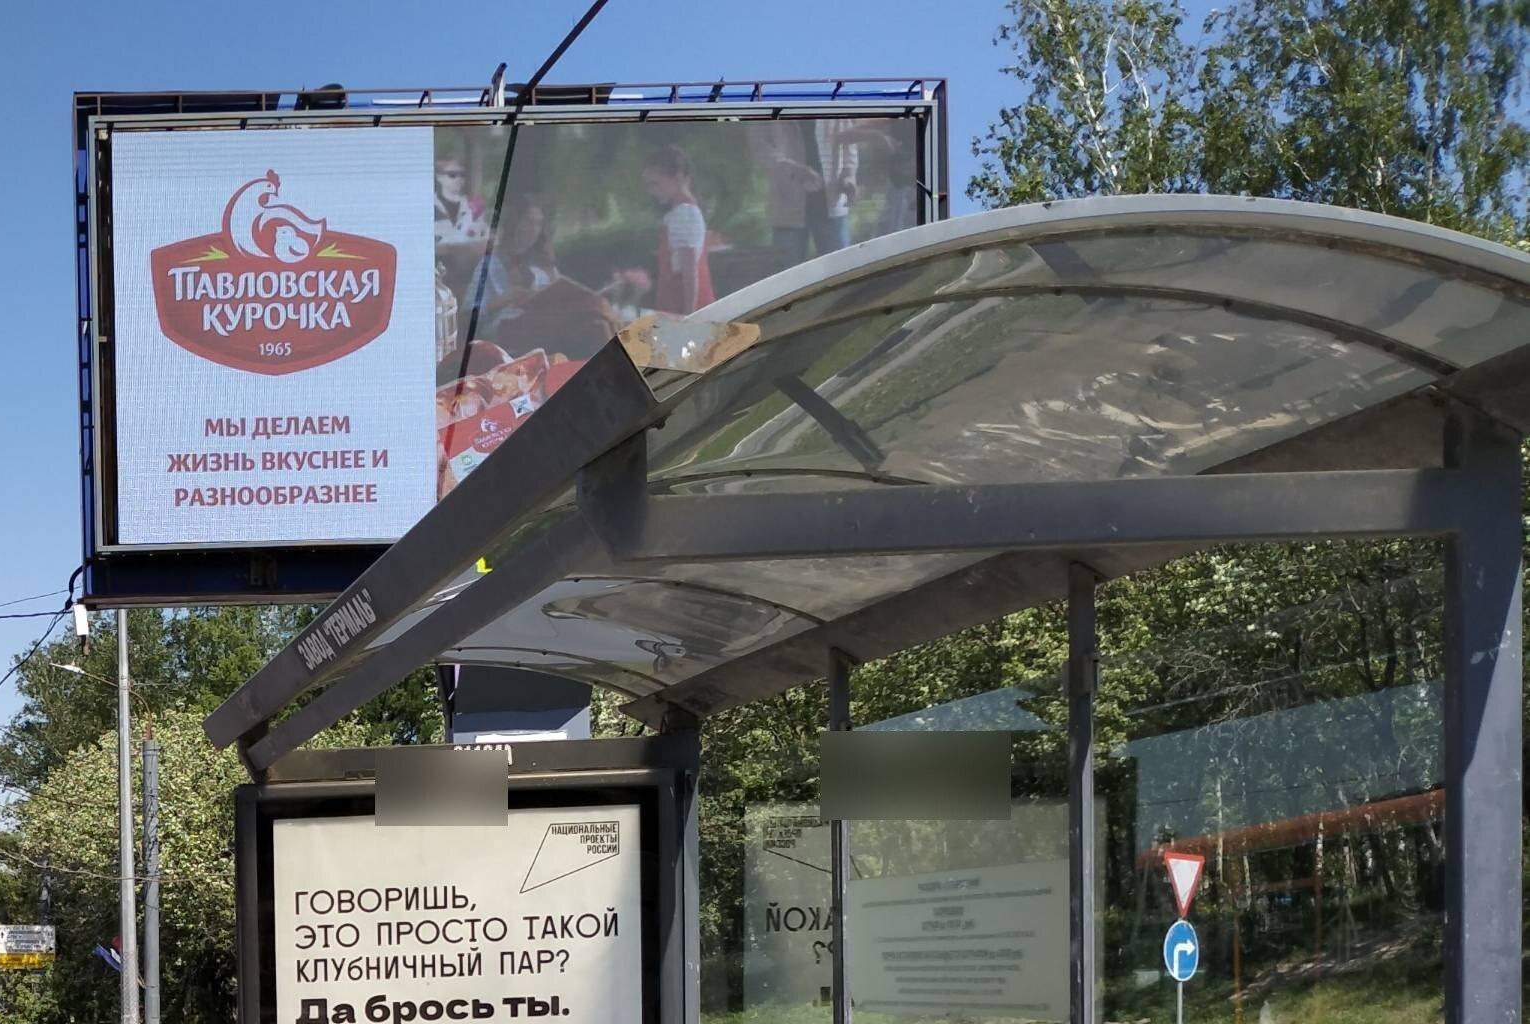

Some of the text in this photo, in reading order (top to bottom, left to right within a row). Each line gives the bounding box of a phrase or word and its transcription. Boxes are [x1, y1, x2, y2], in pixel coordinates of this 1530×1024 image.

[168, 266, 380, 304] ПАВЛОВСКАЯ
[202, 302, 351, 336] КУРОЧКА
[259, 342, 292, 356] 1965
[204, 415, 350, 440] МЫ ДЕЛАЕМ
[167, 449, 388, 473] ЖИЗНЬ ВКУСНЕЕ И
[174, 484, 377, 507] РАЗНООБРАЗНЕЕ
[297, 628, 337, 671] ЗАВОД
[551, 823, 617, 836] НАЦИОНАЛЬНЫЕ
[580, 833, 617, 844] ПРОЕКТЫ
[587, 844, 617, 854] РОССИИ
[295, 885, 476, 915] ГОВОРИШЬ,
[295, 907, 619, 949] ЭТО ПРОСТО ТАКОЙ
[499, 949, 570, 975] ПАР?
[502, 995, 570, 1018] ты.
